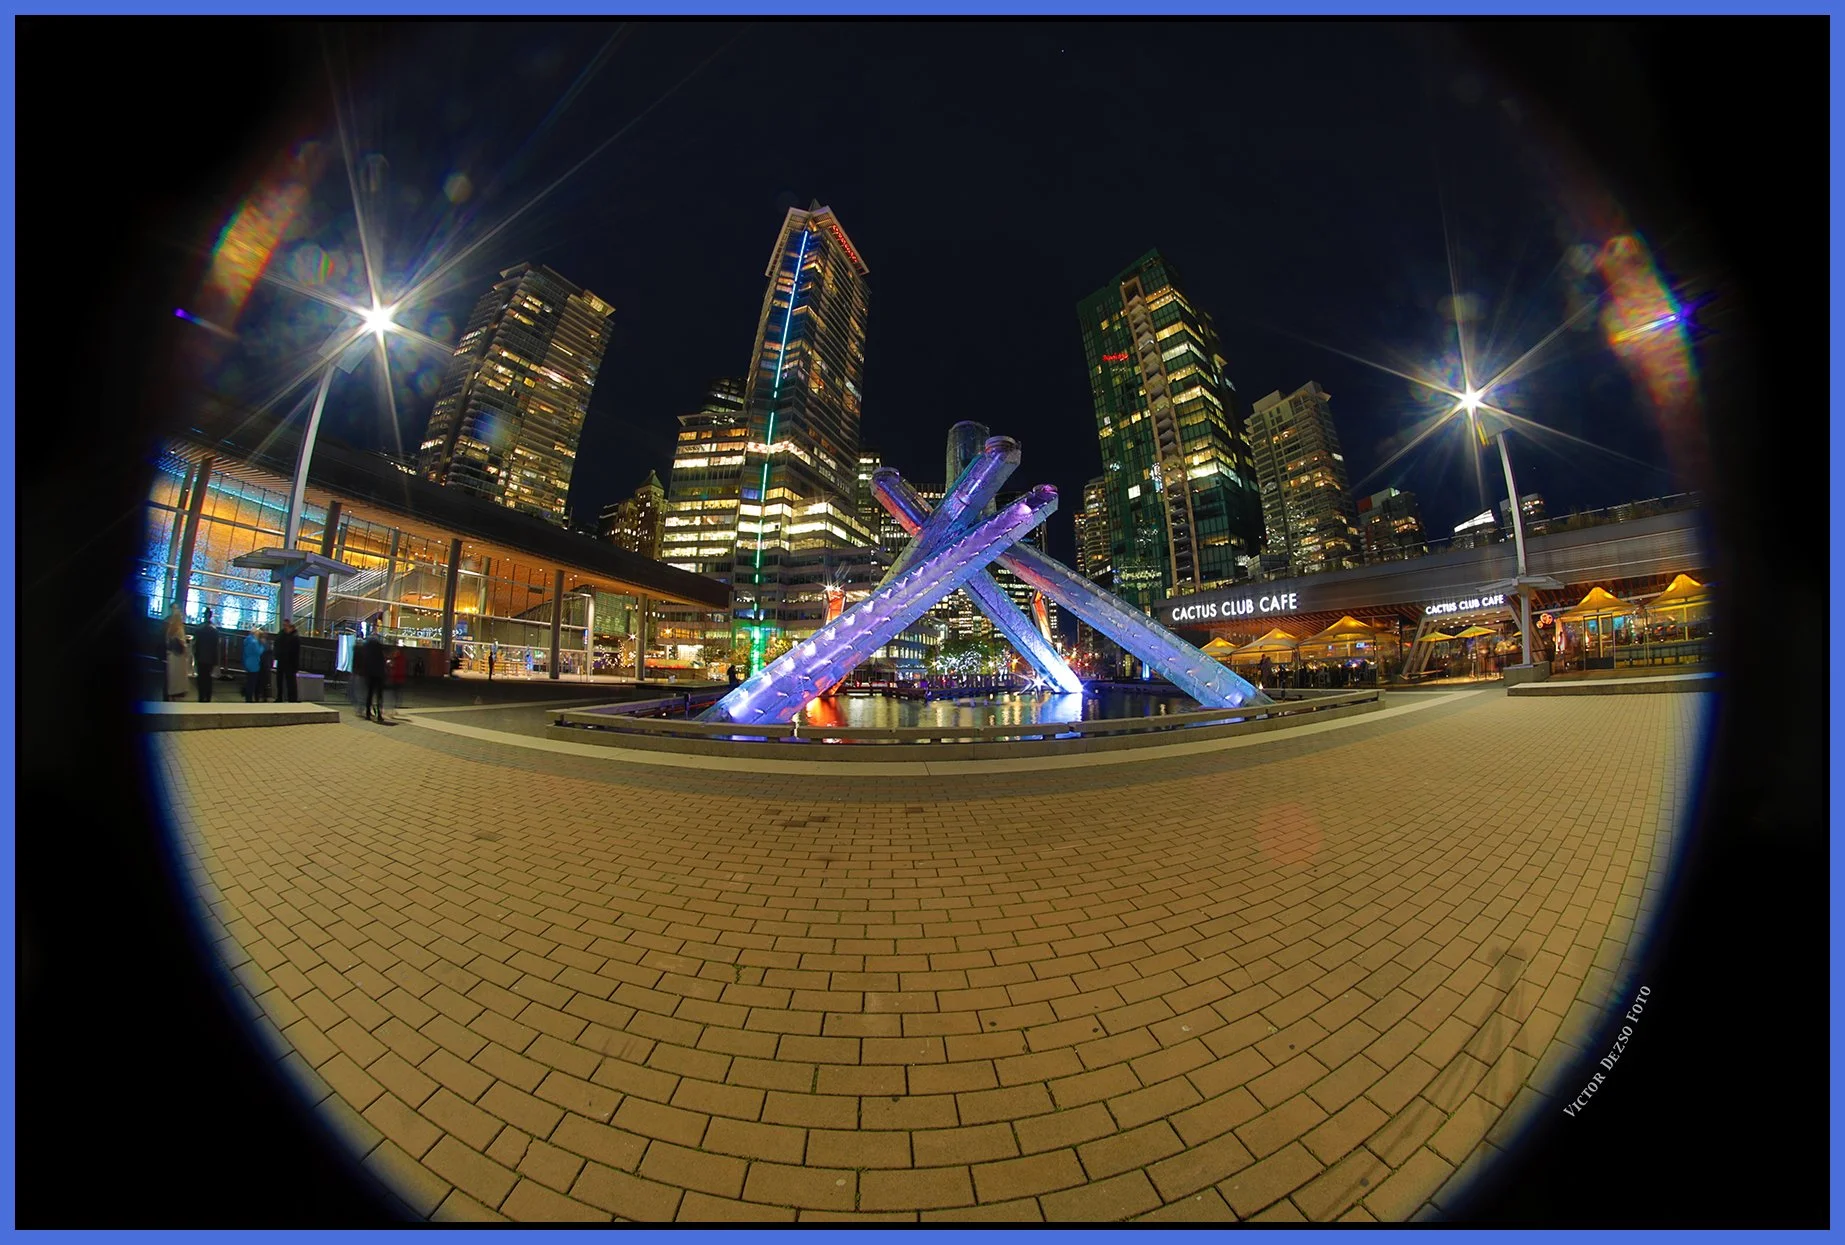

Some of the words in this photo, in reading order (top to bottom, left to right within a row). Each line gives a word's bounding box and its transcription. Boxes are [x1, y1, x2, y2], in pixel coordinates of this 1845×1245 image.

[1172, 603, 1217, 621] CACTUS
[1221, 598, 1254, 616] CLUB
[1259, 592, 1298, 611] CAFE
[1425, 602, 1457, 615] CACTUS
[1458, 598, 1480, 610] CLUB
[1481, 594, 1504, 607] CAFE
